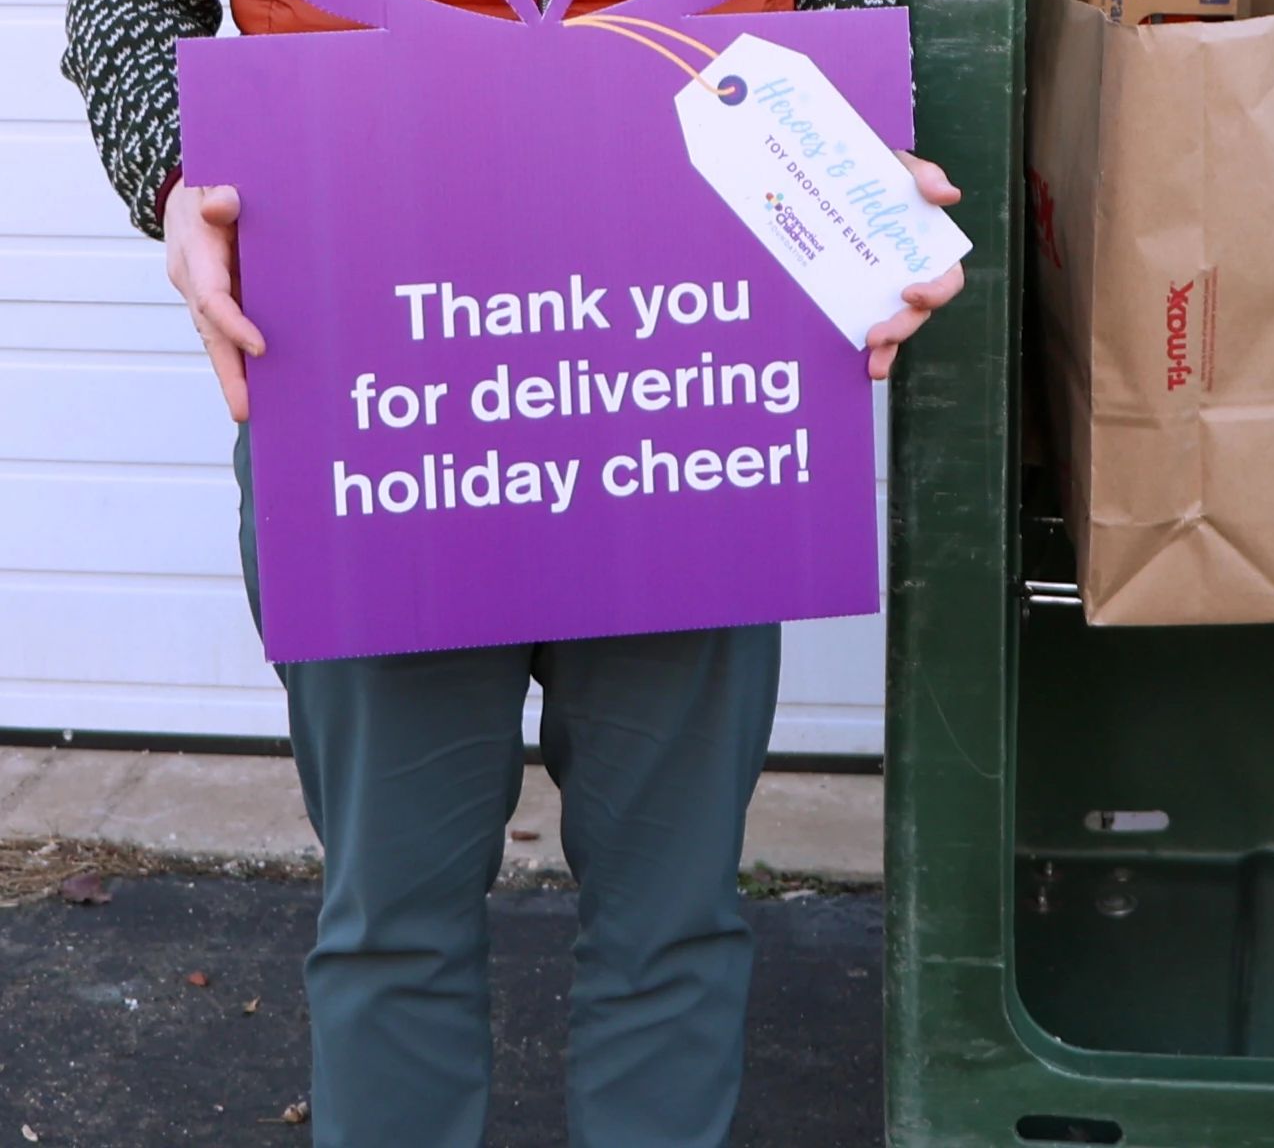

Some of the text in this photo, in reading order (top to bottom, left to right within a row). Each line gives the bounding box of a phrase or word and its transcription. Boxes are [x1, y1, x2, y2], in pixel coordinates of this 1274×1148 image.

[754, 77, 933, 273] Heroes & Helpers
[764, 135, 880, 267] TOY DROP-OFF EVENT
[784, 206, 825, 252] Connecticut
[396, 275, 749, 339] Thank you
[351, 353, 799, 428] for delivering
[334, 429, 808, 515] holiday cheer!
